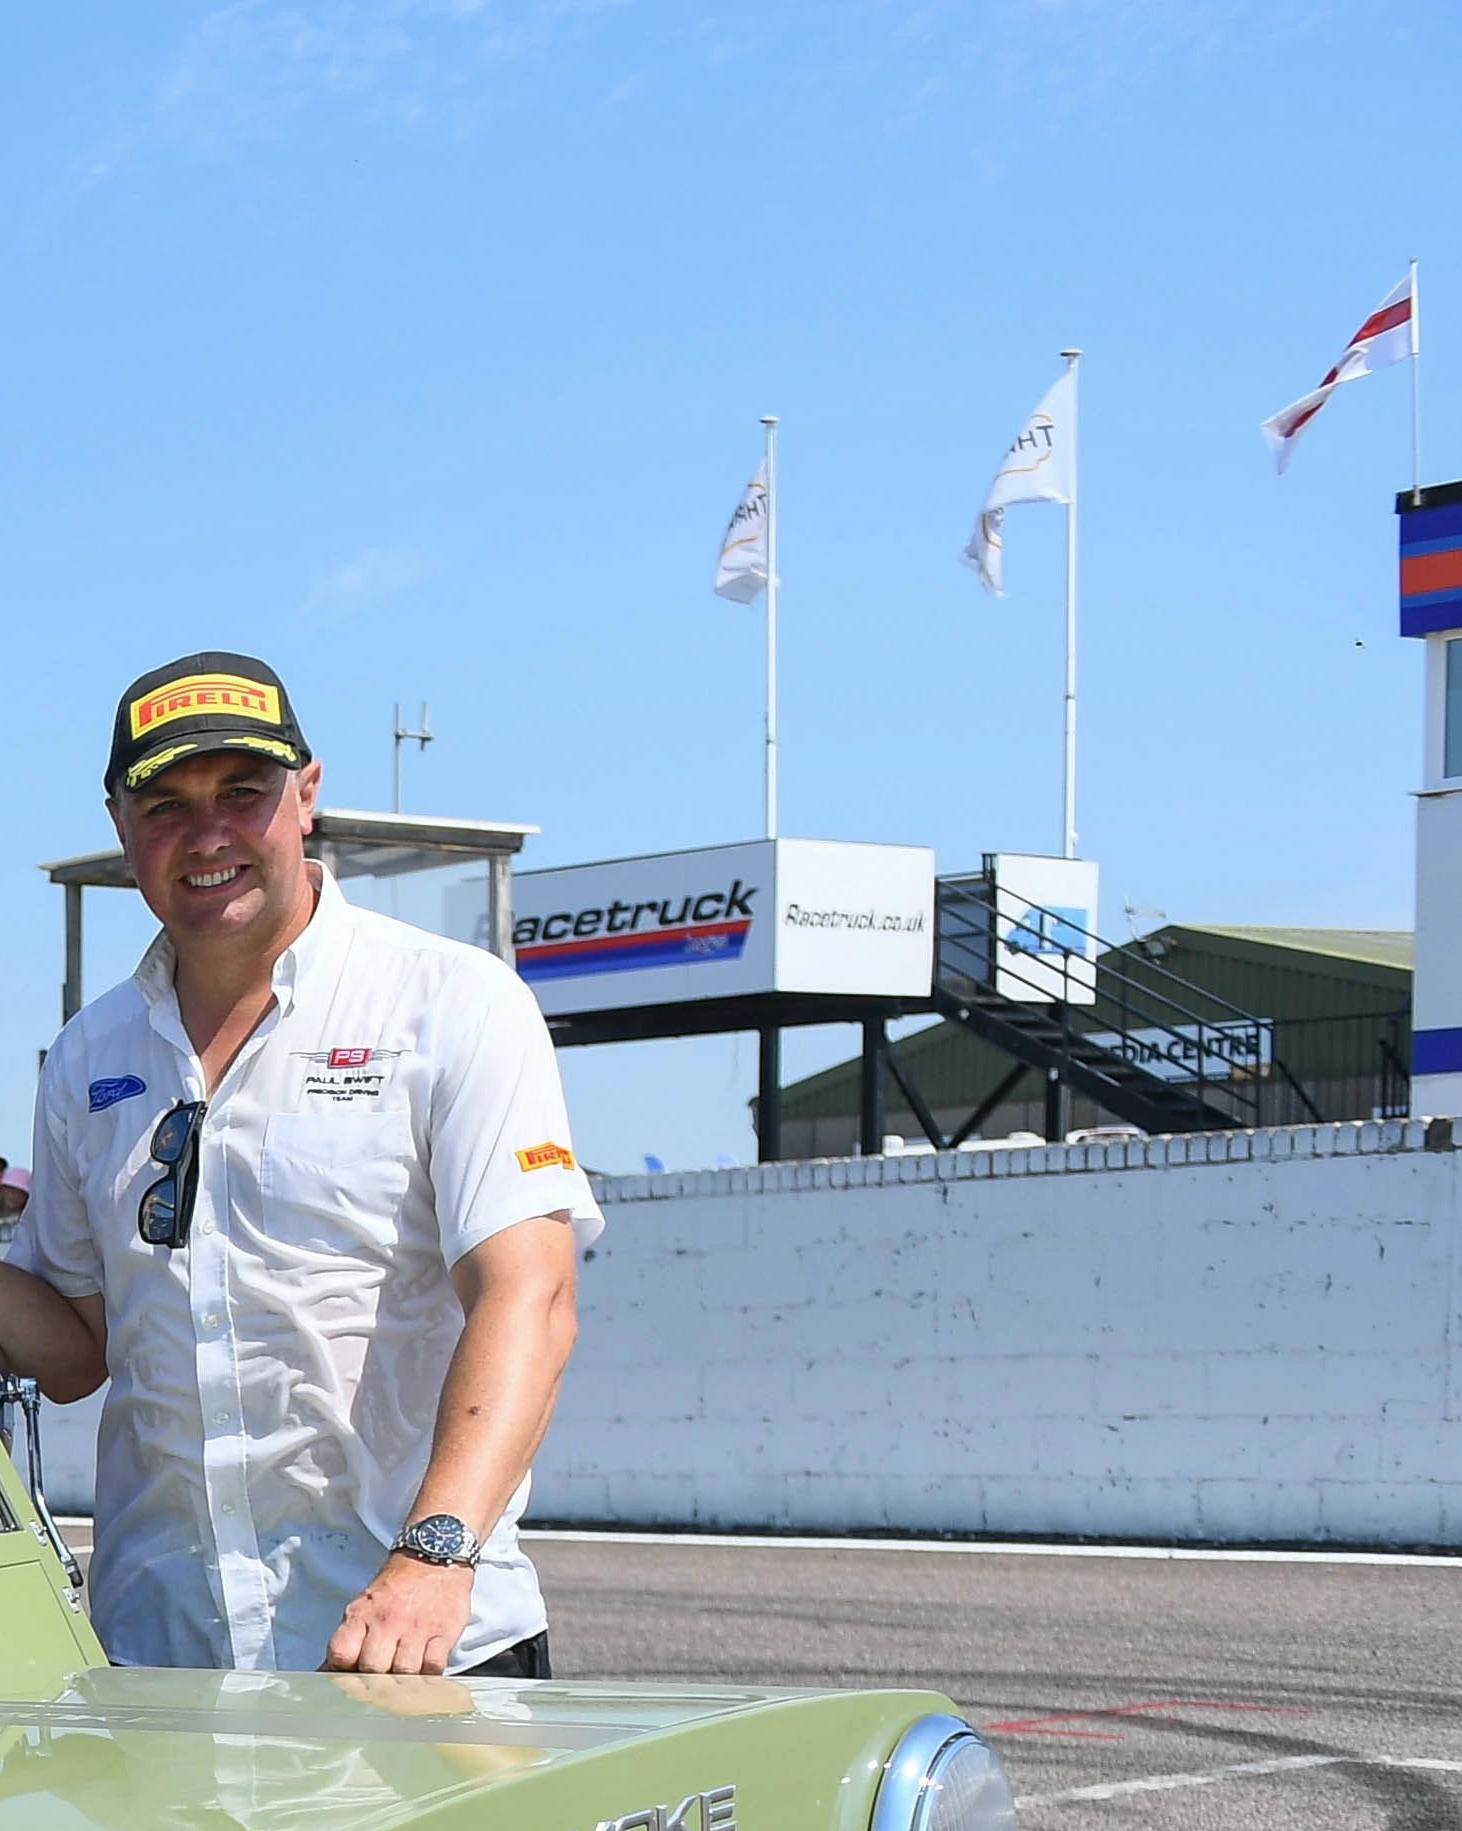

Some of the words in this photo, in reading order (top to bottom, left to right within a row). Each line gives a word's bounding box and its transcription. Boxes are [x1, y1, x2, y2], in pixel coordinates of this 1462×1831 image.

[139, 681, 267, 727] PIRELLI
[511, 878, 758, 944] acetruck
[785, 902, 925, 932] Racetruck.co.uk
[306, 1076, 339, 1085] PAUL
[343, 1075, 385, 1085] SWIFT
